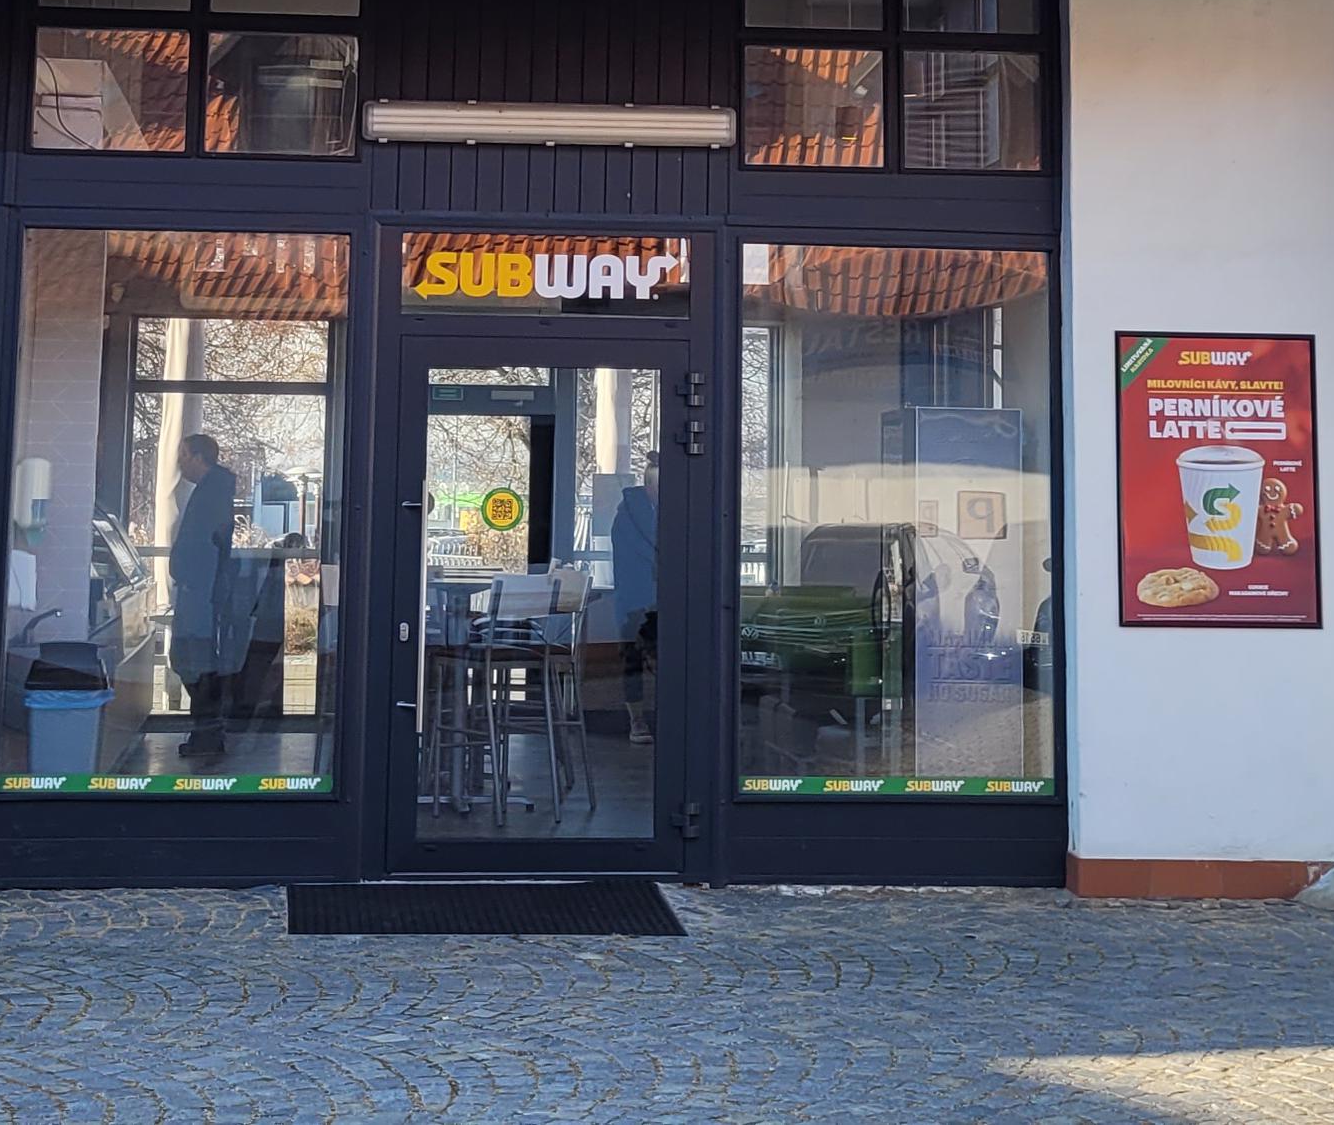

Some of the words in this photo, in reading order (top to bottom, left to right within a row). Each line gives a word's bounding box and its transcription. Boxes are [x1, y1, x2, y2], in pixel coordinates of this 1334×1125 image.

[414, 251, 679, 300] SUBWAY
[1178, 350, 1253, 366] SUBWAY
[1147, 378, 1205, 389] MILOVNÍCI
[1207, 378, 1238, 390] KÁVY,
[1240, 380, 1284, 390] SLAVTE!
[1148, 394, 1285, 418] PERNÍKOVÉ
[1149, 420, 1222, 439] LATTE
[3, 776, 66, 789] SUBWAY
[88, 777, 152, 790] SUBWAY
[173, 777, 237, 791] SUBWAY
[258, 777, 321, 791] SUBWAY
[743, 779, 803, 792] SUBWAY
[823, 779, 884, 793] SUBWAY
[905, 780, 965, 793] SUBWAY
[985, 780, 1045, 794] SUBWAY
